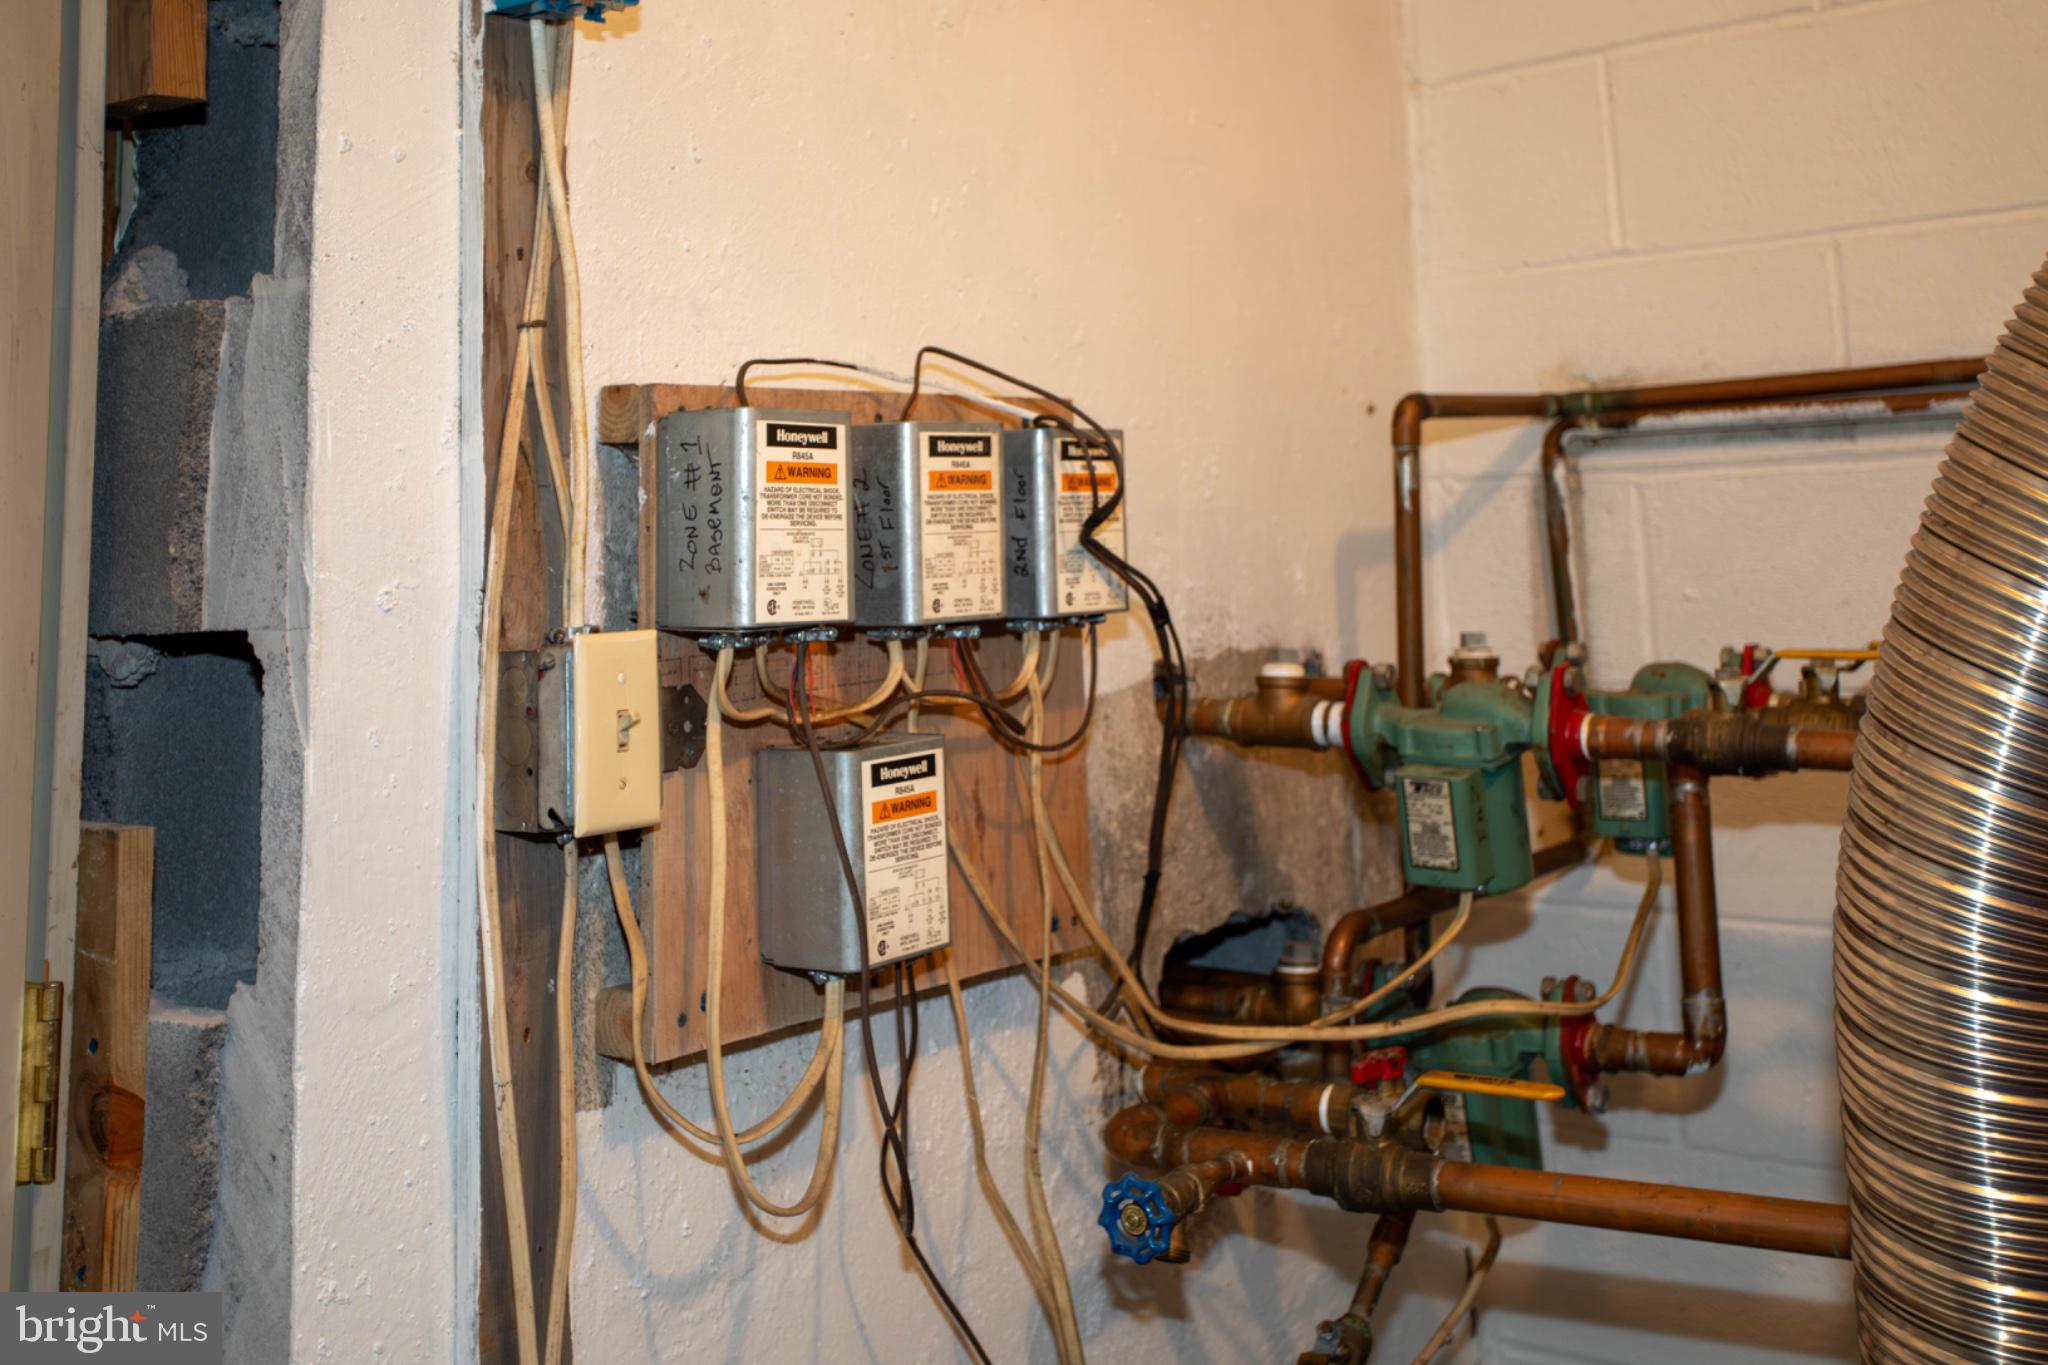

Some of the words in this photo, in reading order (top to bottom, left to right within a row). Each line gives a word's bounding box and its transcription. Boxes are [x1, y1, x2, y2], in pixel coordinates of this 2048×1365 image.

[776, 428, 828, 445] Honeywell
[792, 451, 814, 460] R845A
[937, 440, 984, 455] Honeywell
[787, 466, 831, 478] WARNING
[947, 474, 987, 485] WARNING
[1012, 467, 1027, 520] Floor
[877, 475, 895, 531] Floor
[679, 503, 699, 572] ZONE
[880, 760, 928, 780] Honeywell
[890, 796, 932, 814] WARNING
